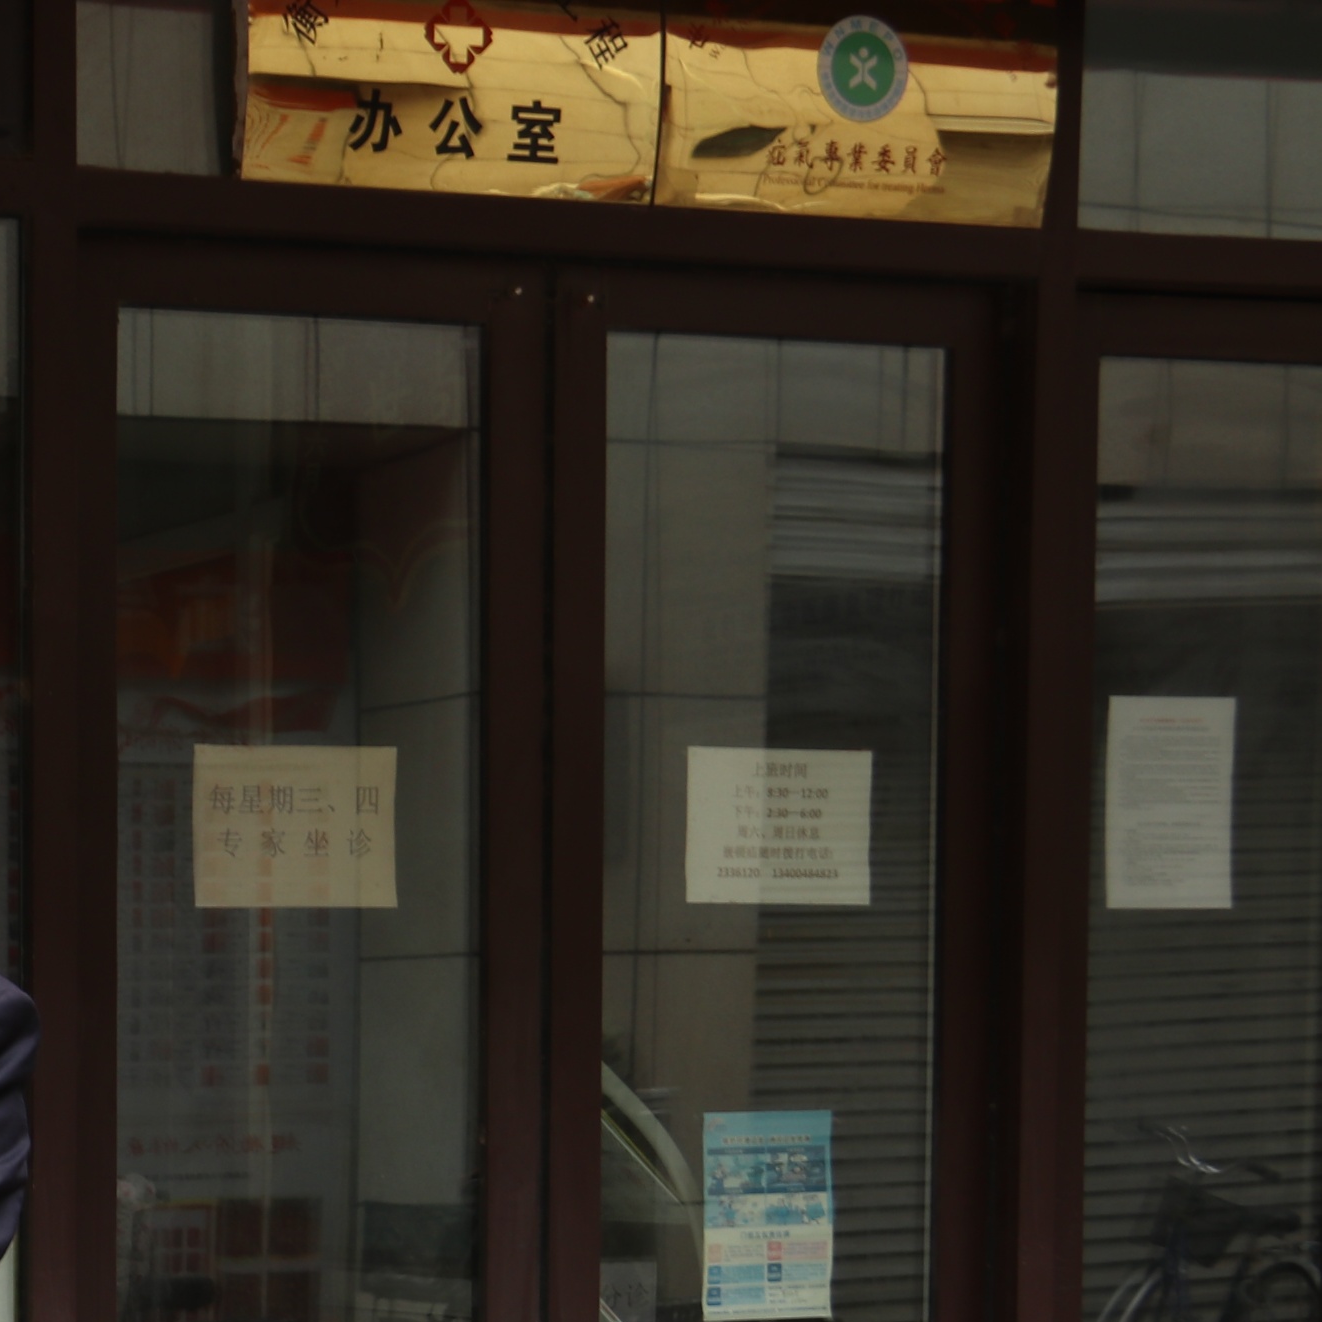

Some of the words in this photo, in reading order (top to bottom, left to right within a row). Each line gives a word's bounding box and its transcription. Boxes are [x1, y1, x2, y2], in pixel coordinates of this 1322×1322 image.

[348, 88, 562, 165] 办公室
[210, 784, 379, 815] 每星期三、四
[216, 827, 373, 859] 专家坐诊
